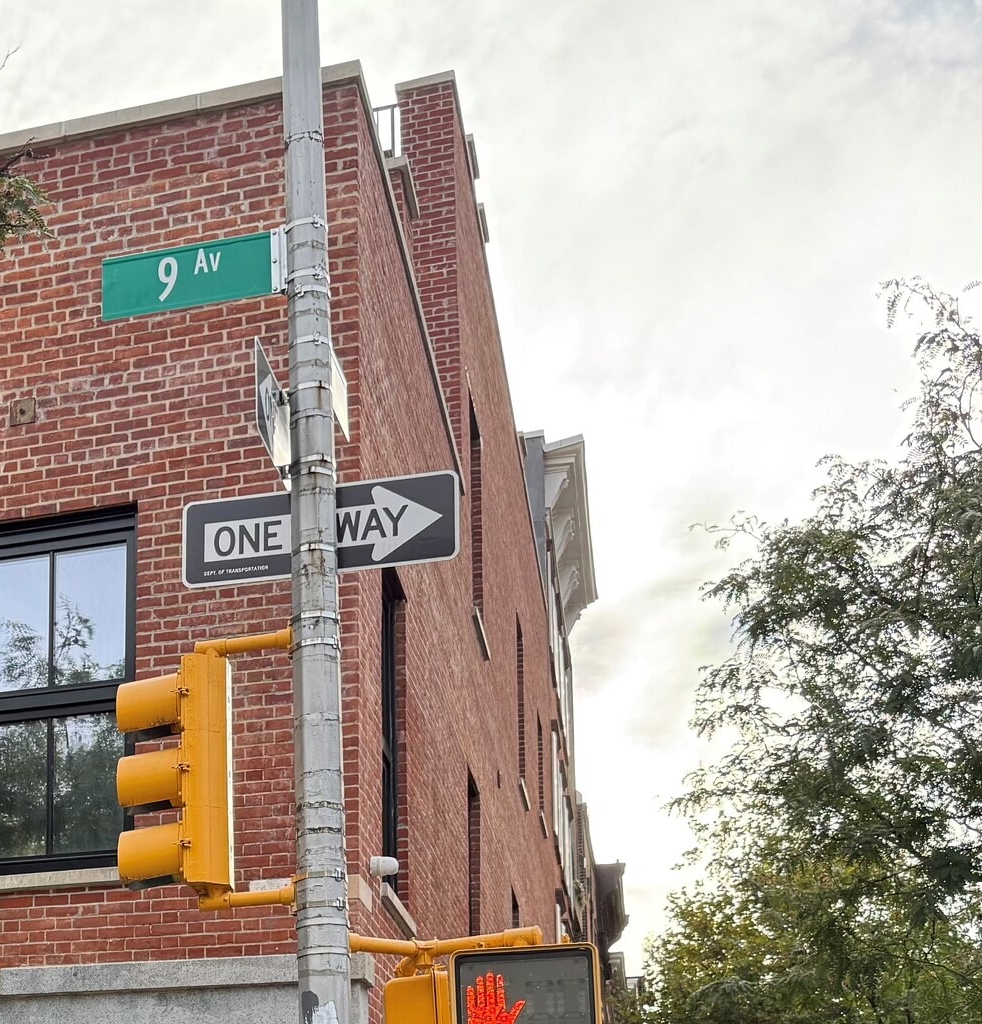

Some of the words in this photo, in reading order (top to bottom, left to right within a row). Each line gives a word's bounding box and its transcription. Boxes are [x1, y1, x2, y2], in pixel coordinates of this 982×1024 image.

[158, 256, 178, 302] 9
[194, 248, 221, 275] Av
[214, 520, 283, 557] ONE
[336, 505, 409, 543] WAY
[225, 564, 269, 574] TRANSPORTATION
